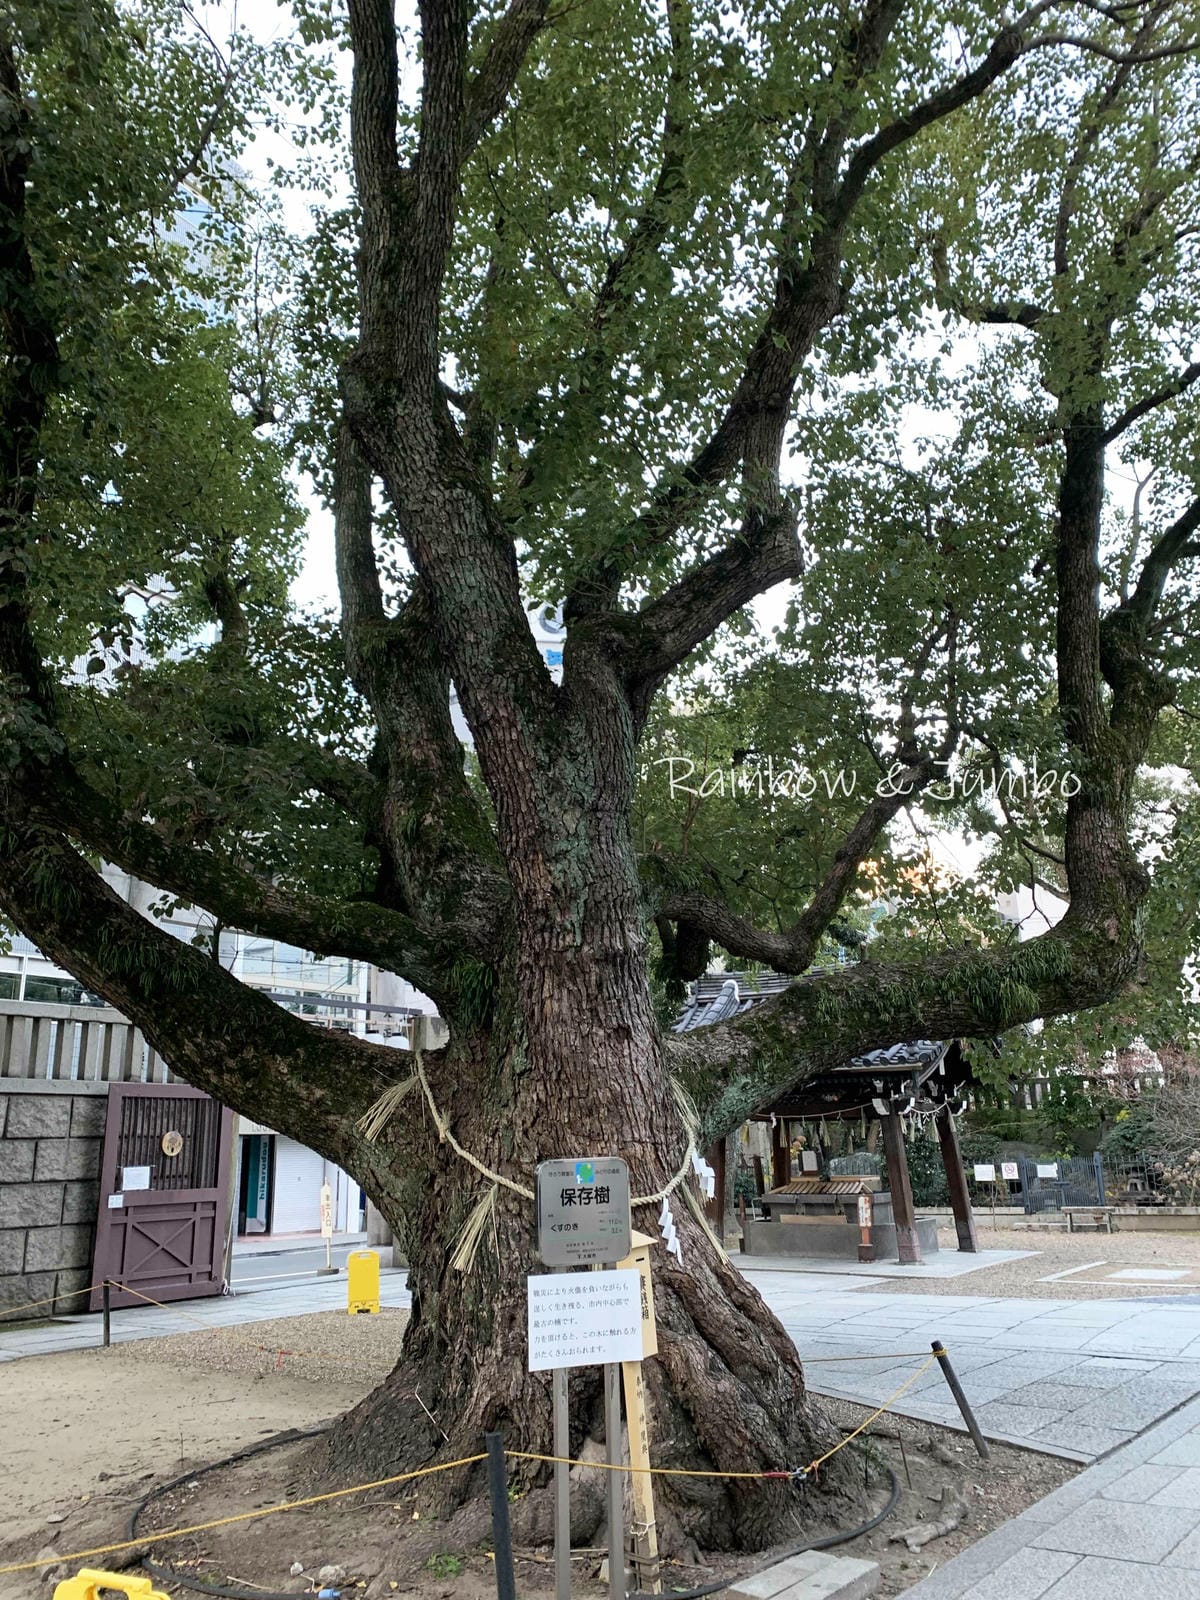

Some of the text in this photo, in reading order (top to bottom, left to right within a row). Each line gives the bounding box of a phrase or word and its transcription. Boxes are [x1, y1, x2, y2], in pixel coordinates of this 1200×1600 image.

[258, 1142, 268, 1200] hikarudou
[560, 1186, 610, 1207] 保存樹
[551, 1222, 579, 1233] くすのき
[534, 1345, 606, 1359] がたくさんおられます。
